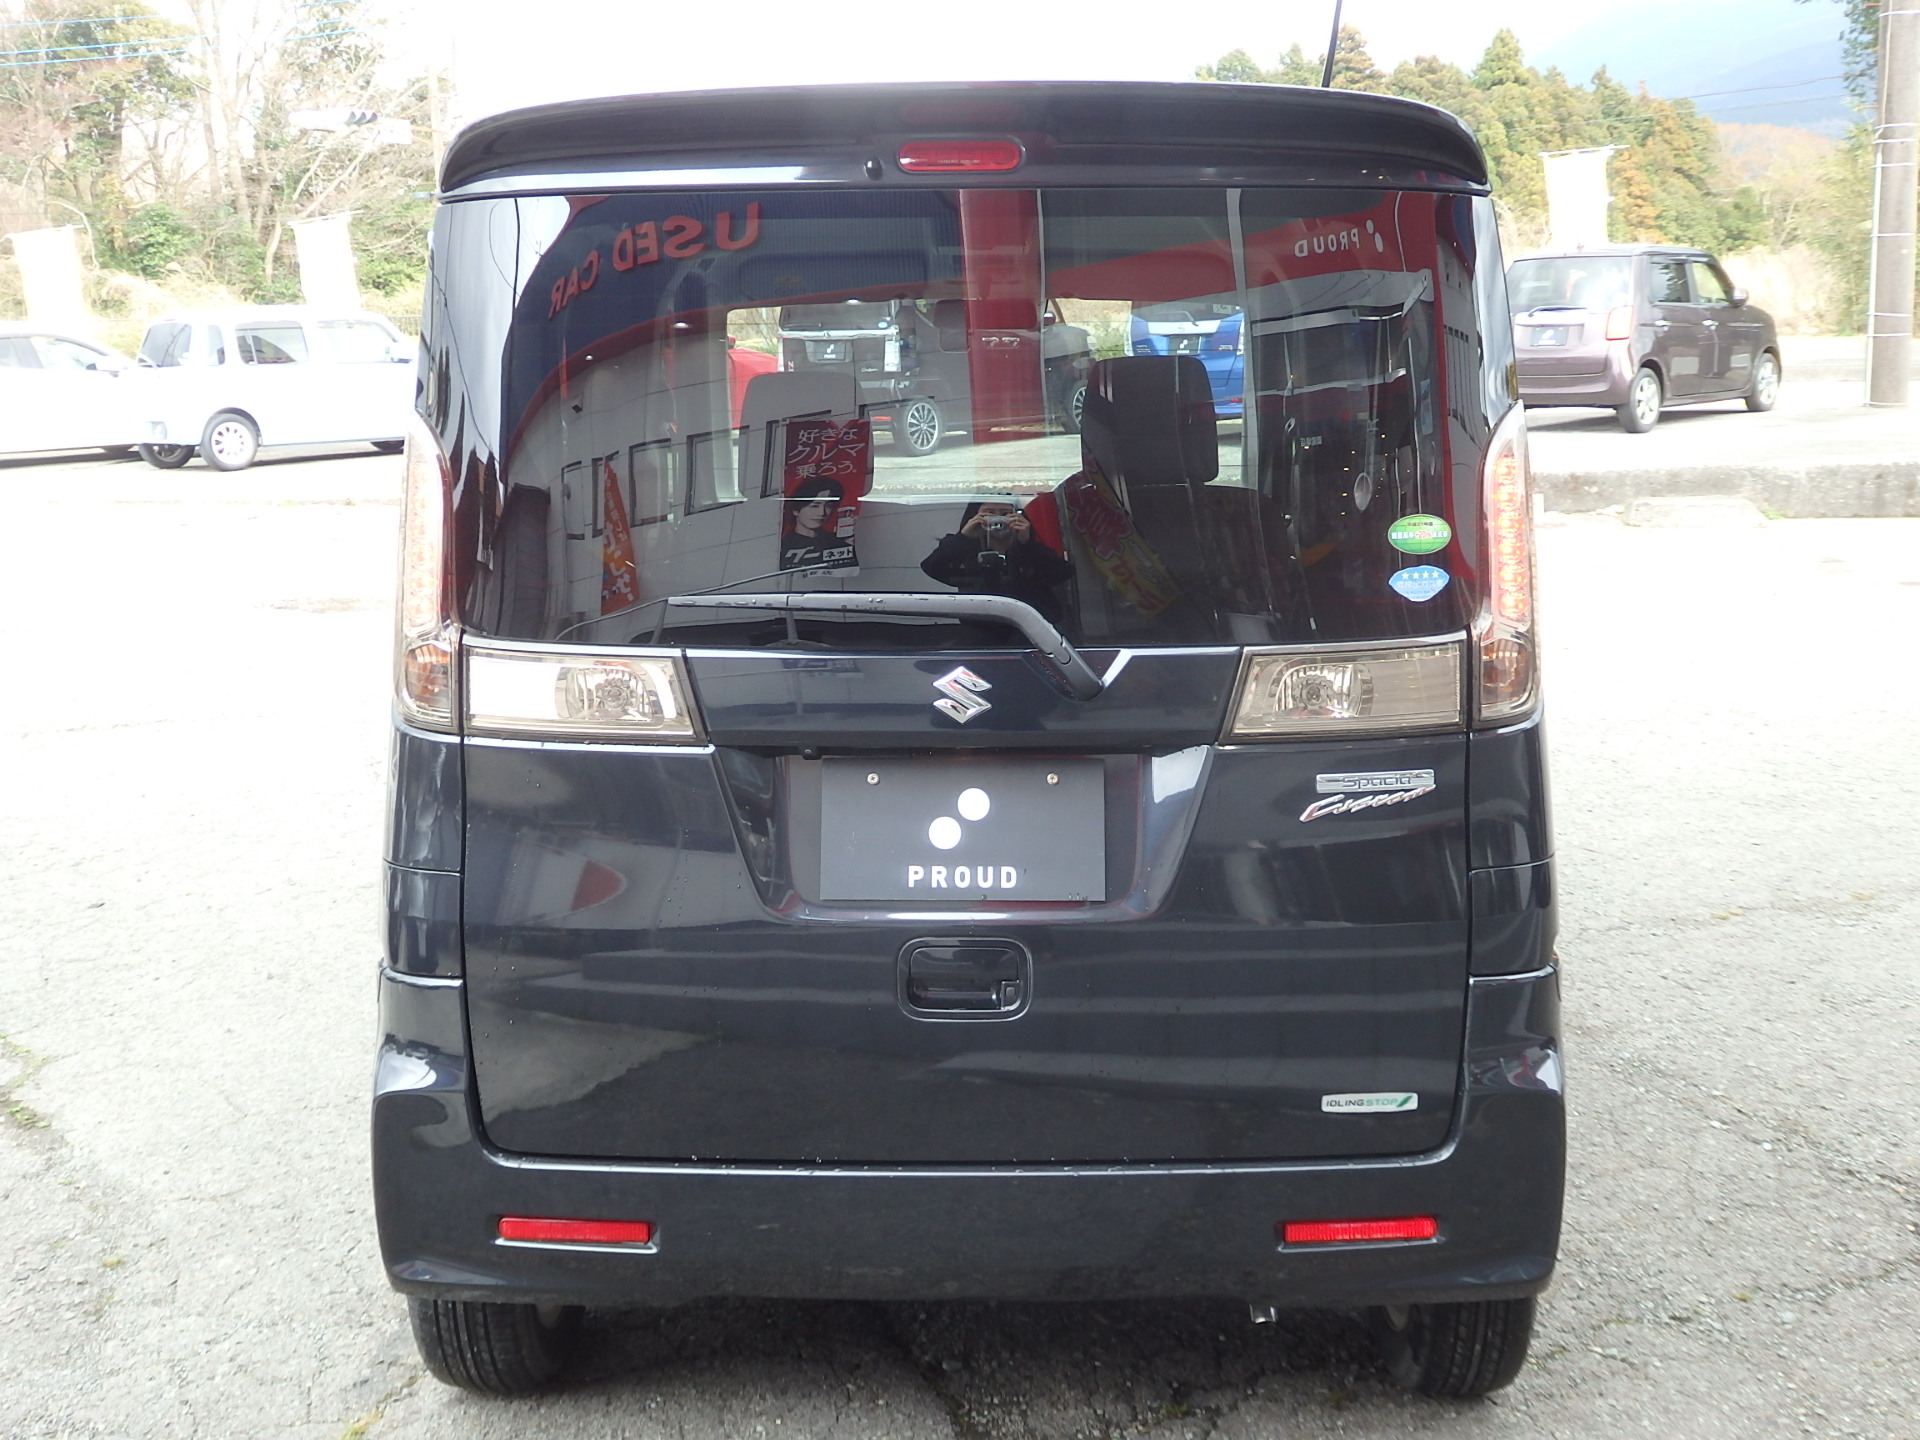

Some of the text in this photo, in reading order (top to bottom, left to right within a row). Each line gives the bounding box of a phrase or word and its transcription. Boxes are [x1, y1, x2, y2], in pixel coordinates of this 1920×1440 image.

[799, 428, 858, 443] 好きな
[788, 442, 866, 464] クルマ
[1342, 775, 1412, 790] Spacia
[907, 865, 1018, 889] PROUD
